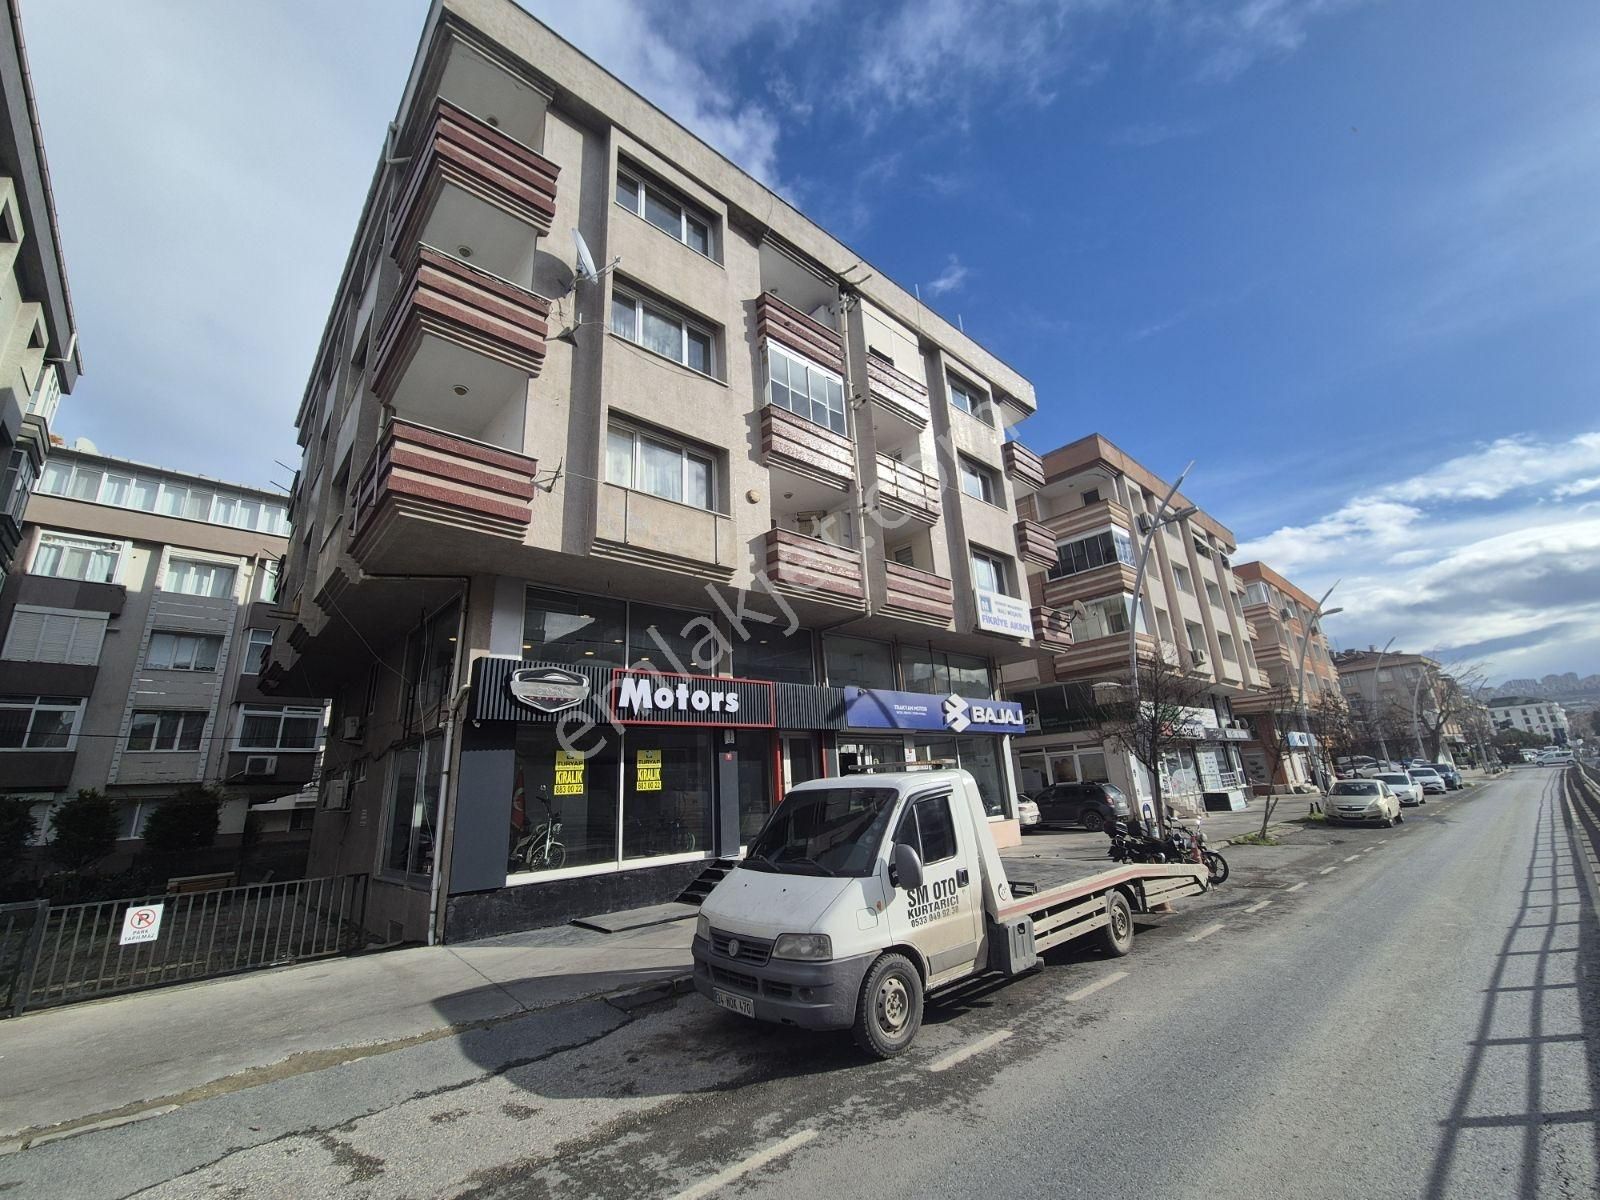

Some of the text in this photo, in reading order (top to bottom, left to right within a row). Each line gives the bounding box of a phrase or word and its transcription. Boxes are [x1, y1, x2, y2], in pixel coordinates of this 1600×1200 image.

[618, 677, 739, 716] Motors
[972, 706, 1024, 725] BAJAJ
[575, 784, 582, 792] 22
[907, 877, 956, 907] SM OTO
[907, 895, 959, 919] KURTARICI
